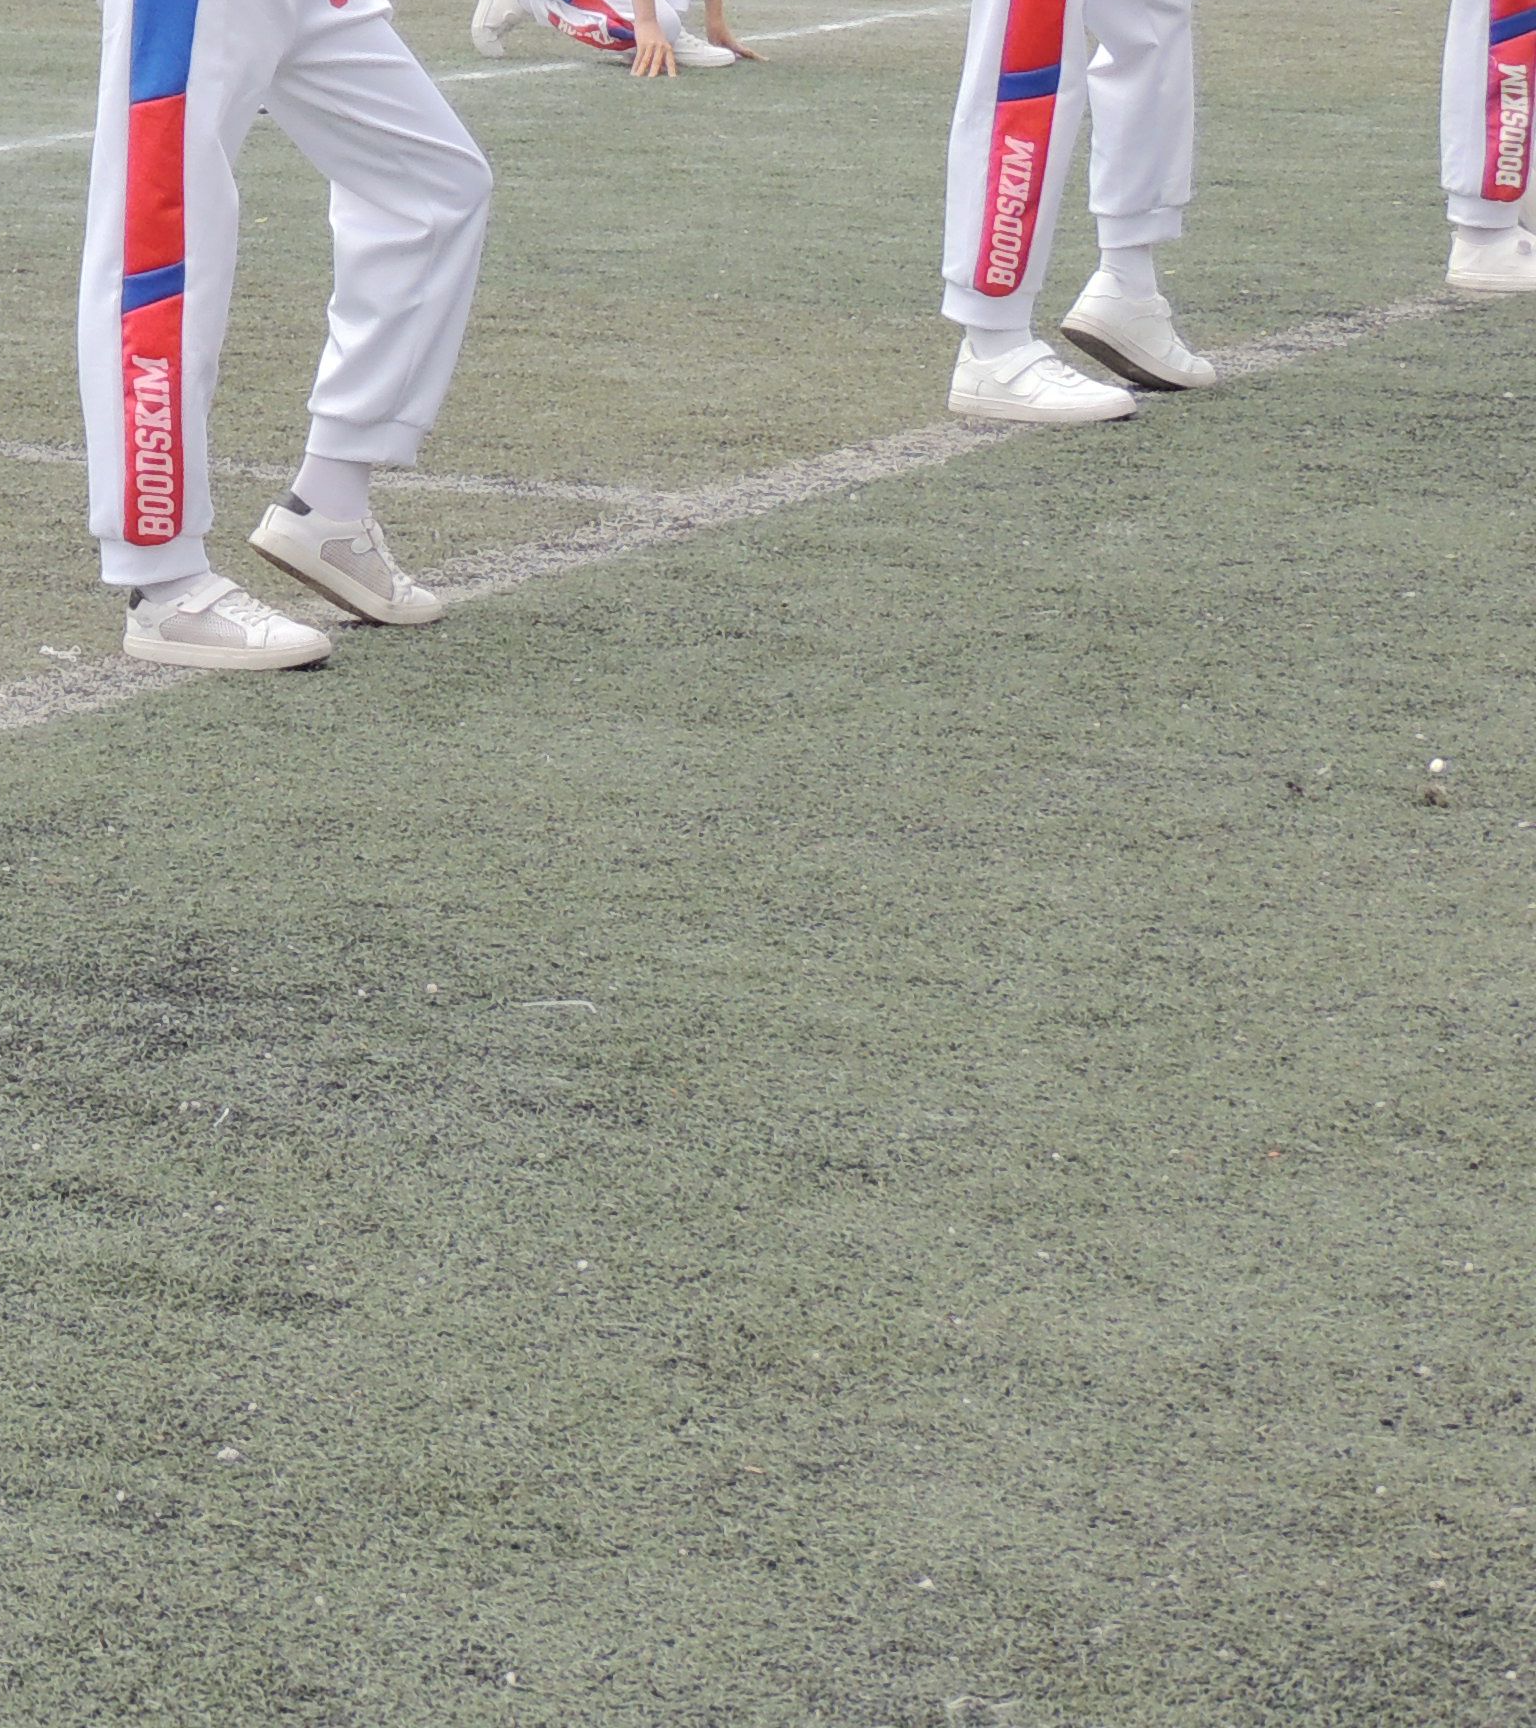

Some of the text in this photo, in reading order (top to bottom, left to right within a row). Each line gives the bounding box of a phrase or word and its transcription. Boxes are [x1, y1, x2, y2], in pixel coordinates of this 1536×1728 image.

[1494, 63, 1529, 190] BOODSKIM
[986, 135, 1036, 289] BOODSKIM
[131, 355, 174, 539] BOODSKIM
